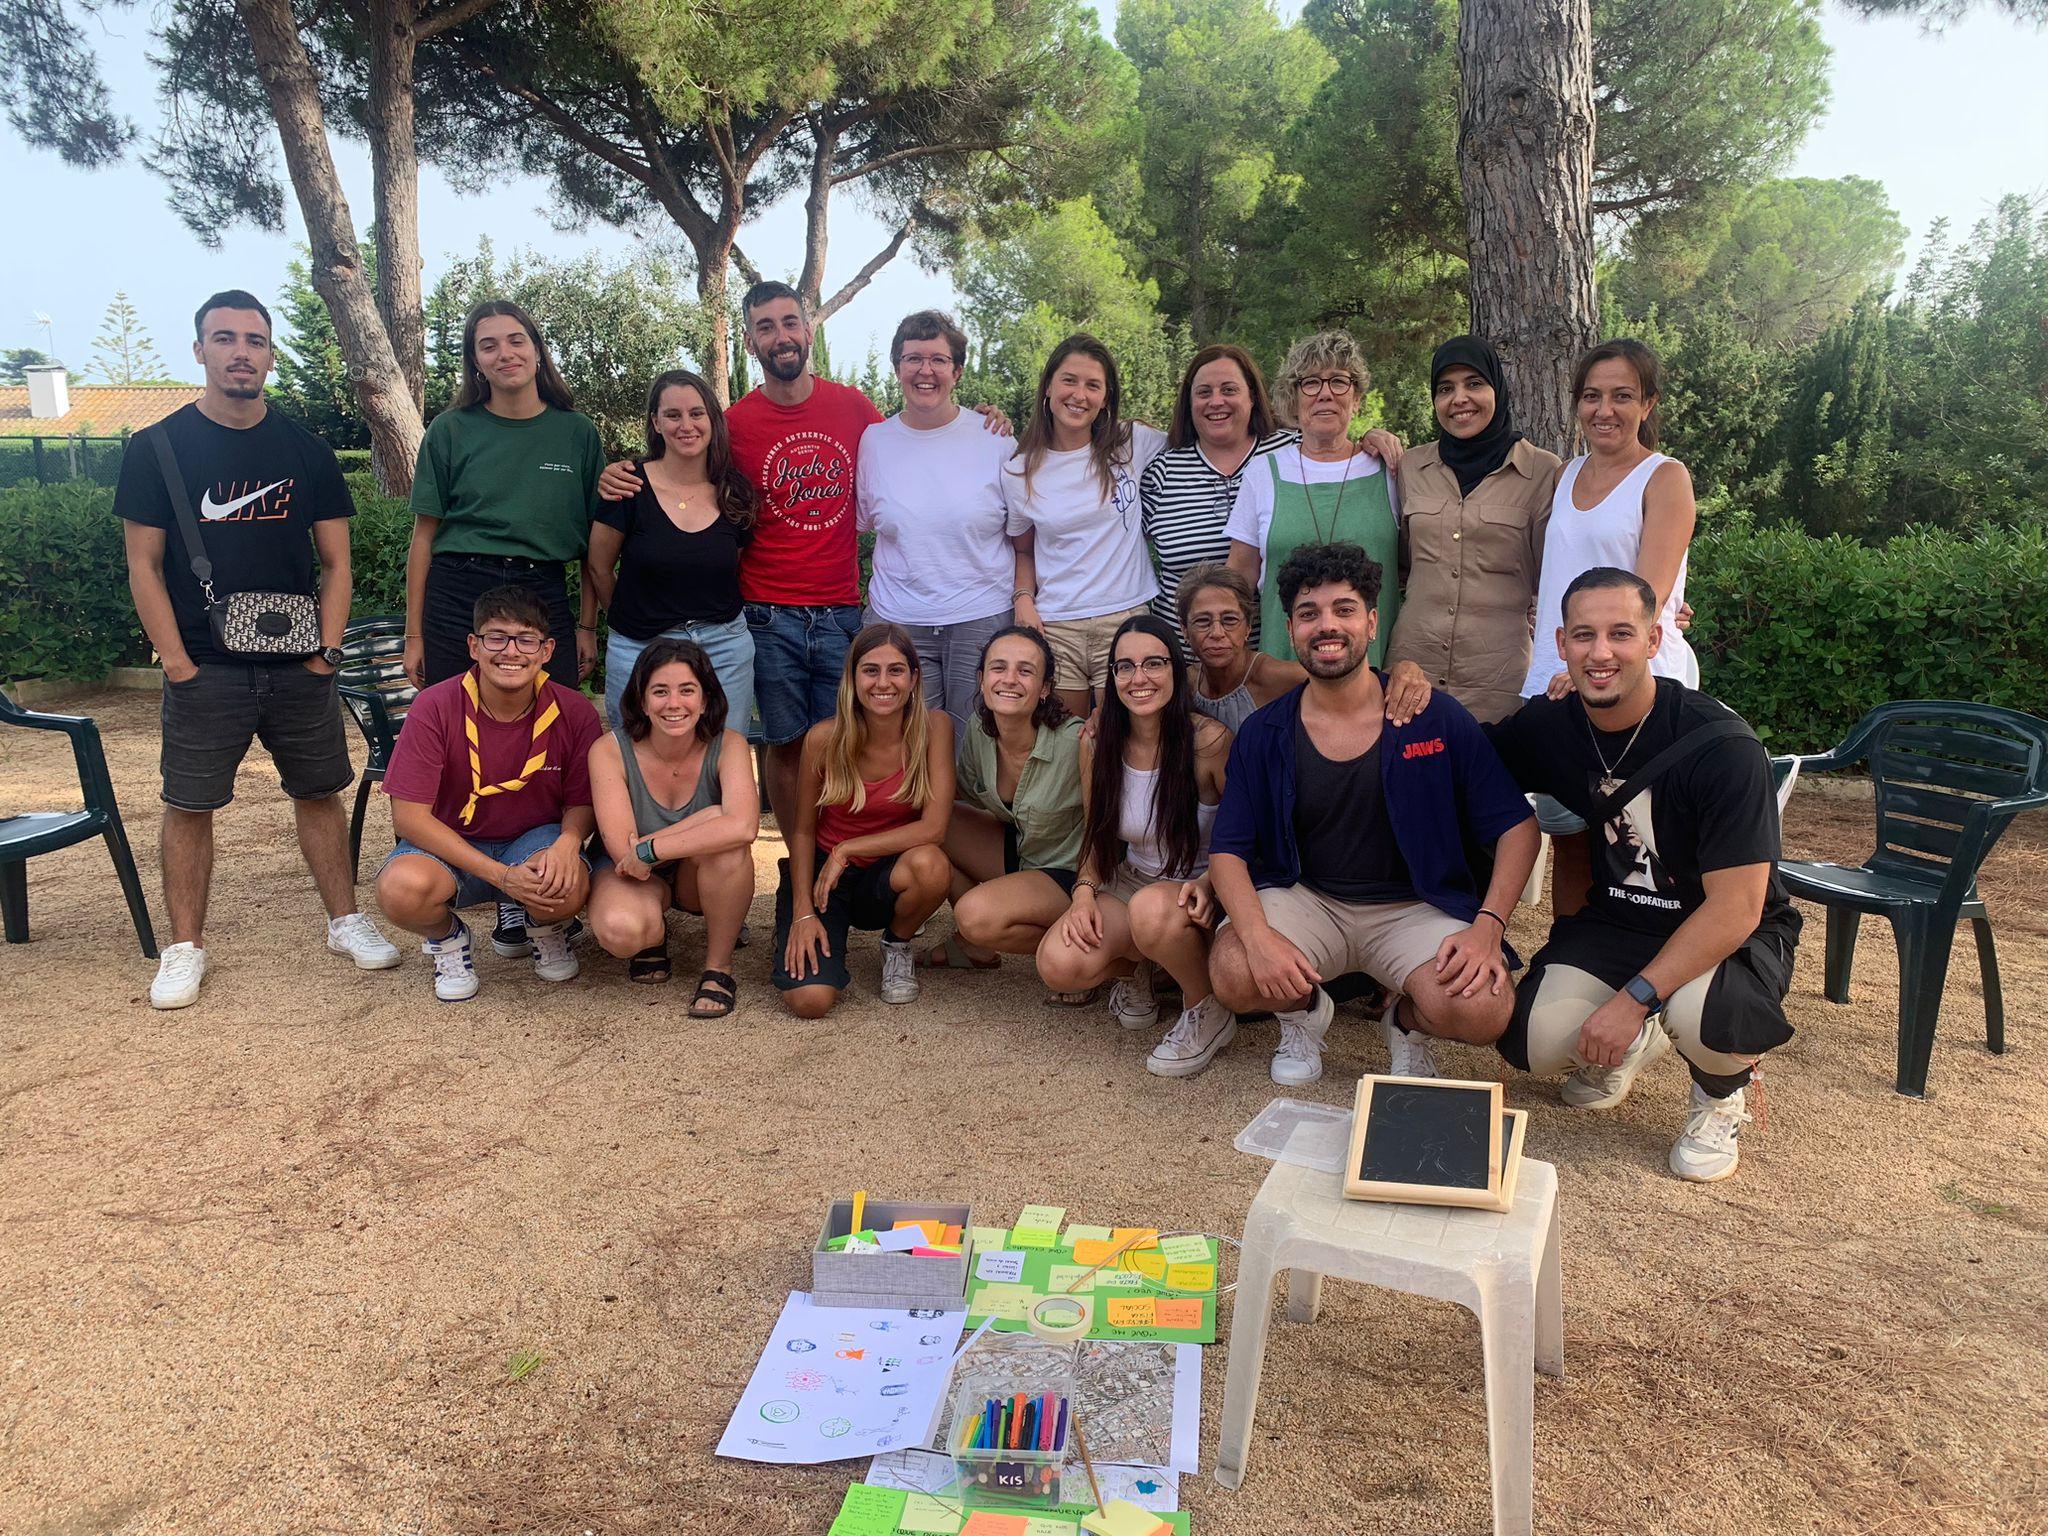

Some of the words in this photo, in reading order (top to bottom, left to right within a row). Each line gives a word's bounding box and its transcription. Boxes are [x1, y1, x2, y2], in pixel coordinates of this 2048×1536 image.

[785, 431, 833, 444] AUTHENTIC
[834, 440, 852, 464] DENIM
[773, 454, 826, 489] Jack
[826, 457, 845, 481] &
[784, 480, 846, 508] Jones
[1402, 737, 1445, 759] JAWS
[1608, 886, 1627, 899] THE
[1627, 893, 1682, 910] GODFATHER
[998, 1474, 1023, 1486] KIS
